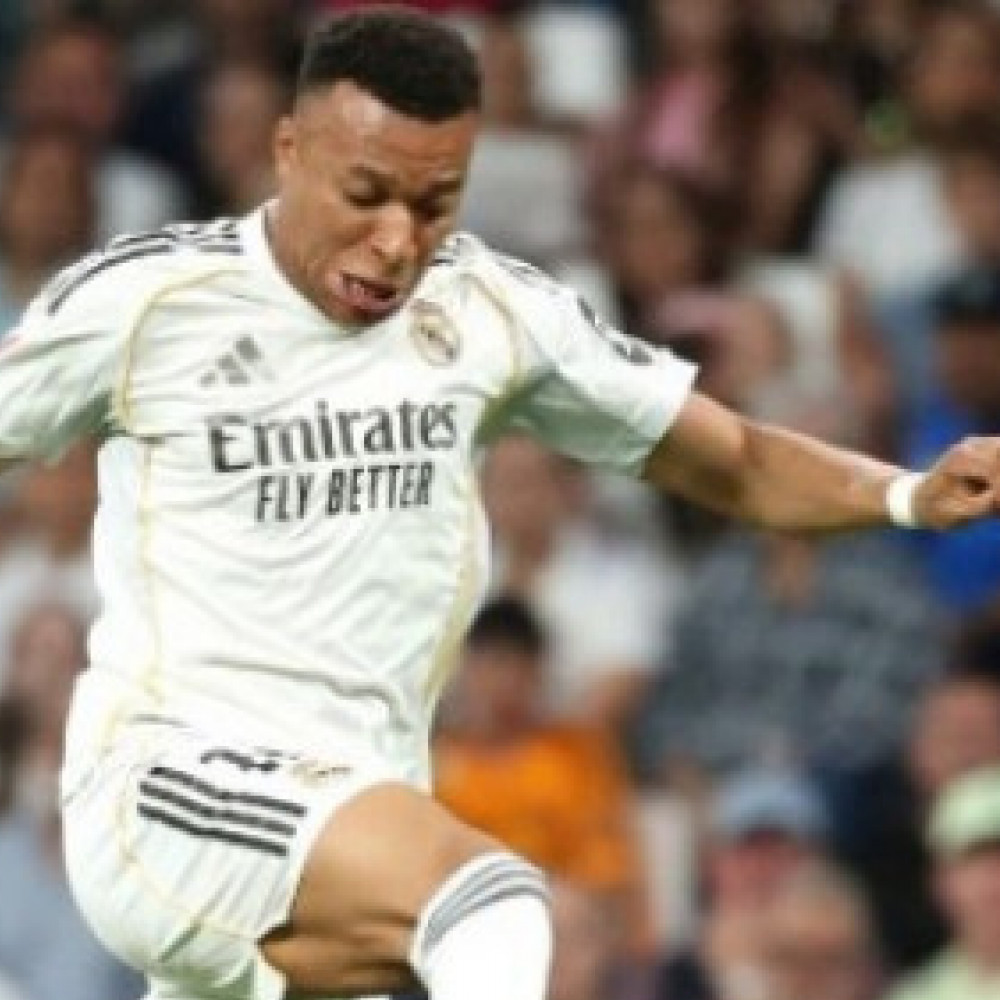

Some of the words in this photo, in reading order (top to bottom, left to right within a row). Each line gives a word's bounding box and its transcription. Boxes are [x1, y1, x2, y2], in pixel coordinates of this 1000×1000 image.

[206, 399, 458, 473] Emirates
[255, 473, 315, 522] FLY
[325, 461, 436, 516] BETTER
